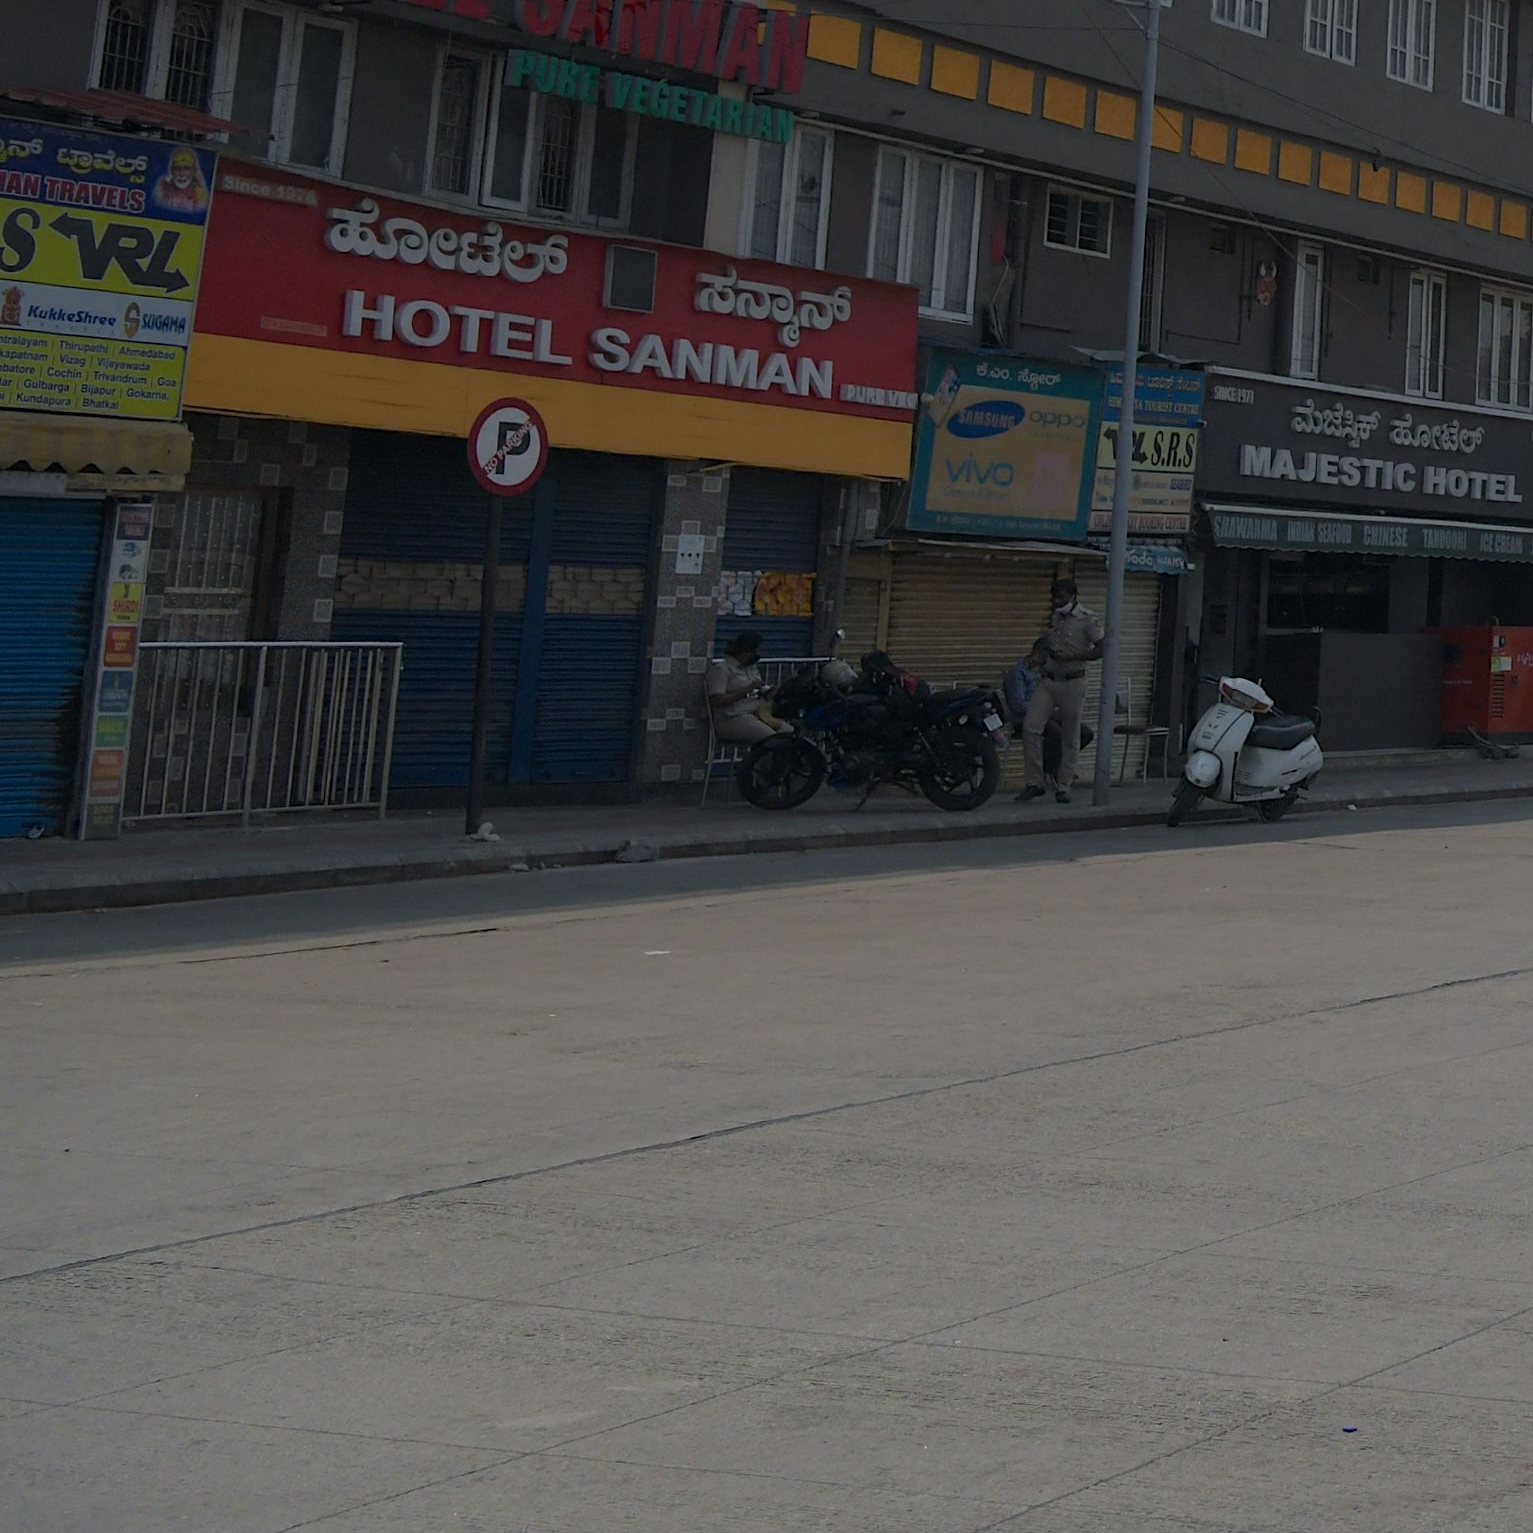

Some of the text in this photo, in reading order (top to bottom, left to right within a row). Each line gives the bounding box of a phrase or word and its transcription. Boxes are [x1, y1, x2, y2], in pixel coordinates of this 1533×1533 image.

[504, 48, 795, 144] PURE VEGETARIAN
[44, 175, 146, 213] TRAVELS
[223, 174, 271, 196] Since
[49, 213, 190, 293] VRL
[325, 198, 569, 283] ಹೋಟೆಲ್
[28, 305, 117, 327] KukkeShree
[142, 313, 186, 335] SUGAMA
[694, 266, 852, 348] ಸನ್ಮಾನ್
[59, 340, 109, 354] Thirupathi
[119, 347, 176, 360] Ahmedabad
[343, 289, 833, 399] HOTEL SANMAN
[47, 368, 82, 379] Cochin
[93, 371, 147, 385] Trivandrum
[157, 377, 177, 388] Goa
[59, 354, 86, 367] Vizag
[97, 357, 151, 372] Vijayawada
[16, 393, 71, 407] Kundapura
[82, 398, 120, 410] Bhatkal
[23, 379, 70, 393] Gulbarga
[80, 384, 116, 397] Bijapur
[958, 409, 1016, 429] SAMSUNG
[1390, 413, 1485, 454] ಹೋಟೆಲ್
[483, 420, 533, 474] NO PARKING
[1151, 431, 1195, 468] S.R.S
[945, 452, 1015, 487] vivo
[1240, 444, 1522, 503] MAJESTIC HOTEL
[1215, 516, 1278, 540] SHAWARMA
[1287, 520, 1315, 542] INDIAN
[1317, 522, 1352, 544] SEAFOOD
[1363, 524, 1408, 548] CHINESE
[1423, 528, 1467, 550] TANDOORI
[1480, 532, 1494, 553] ICE
[1495, 533, 1523, 555] CREAM
